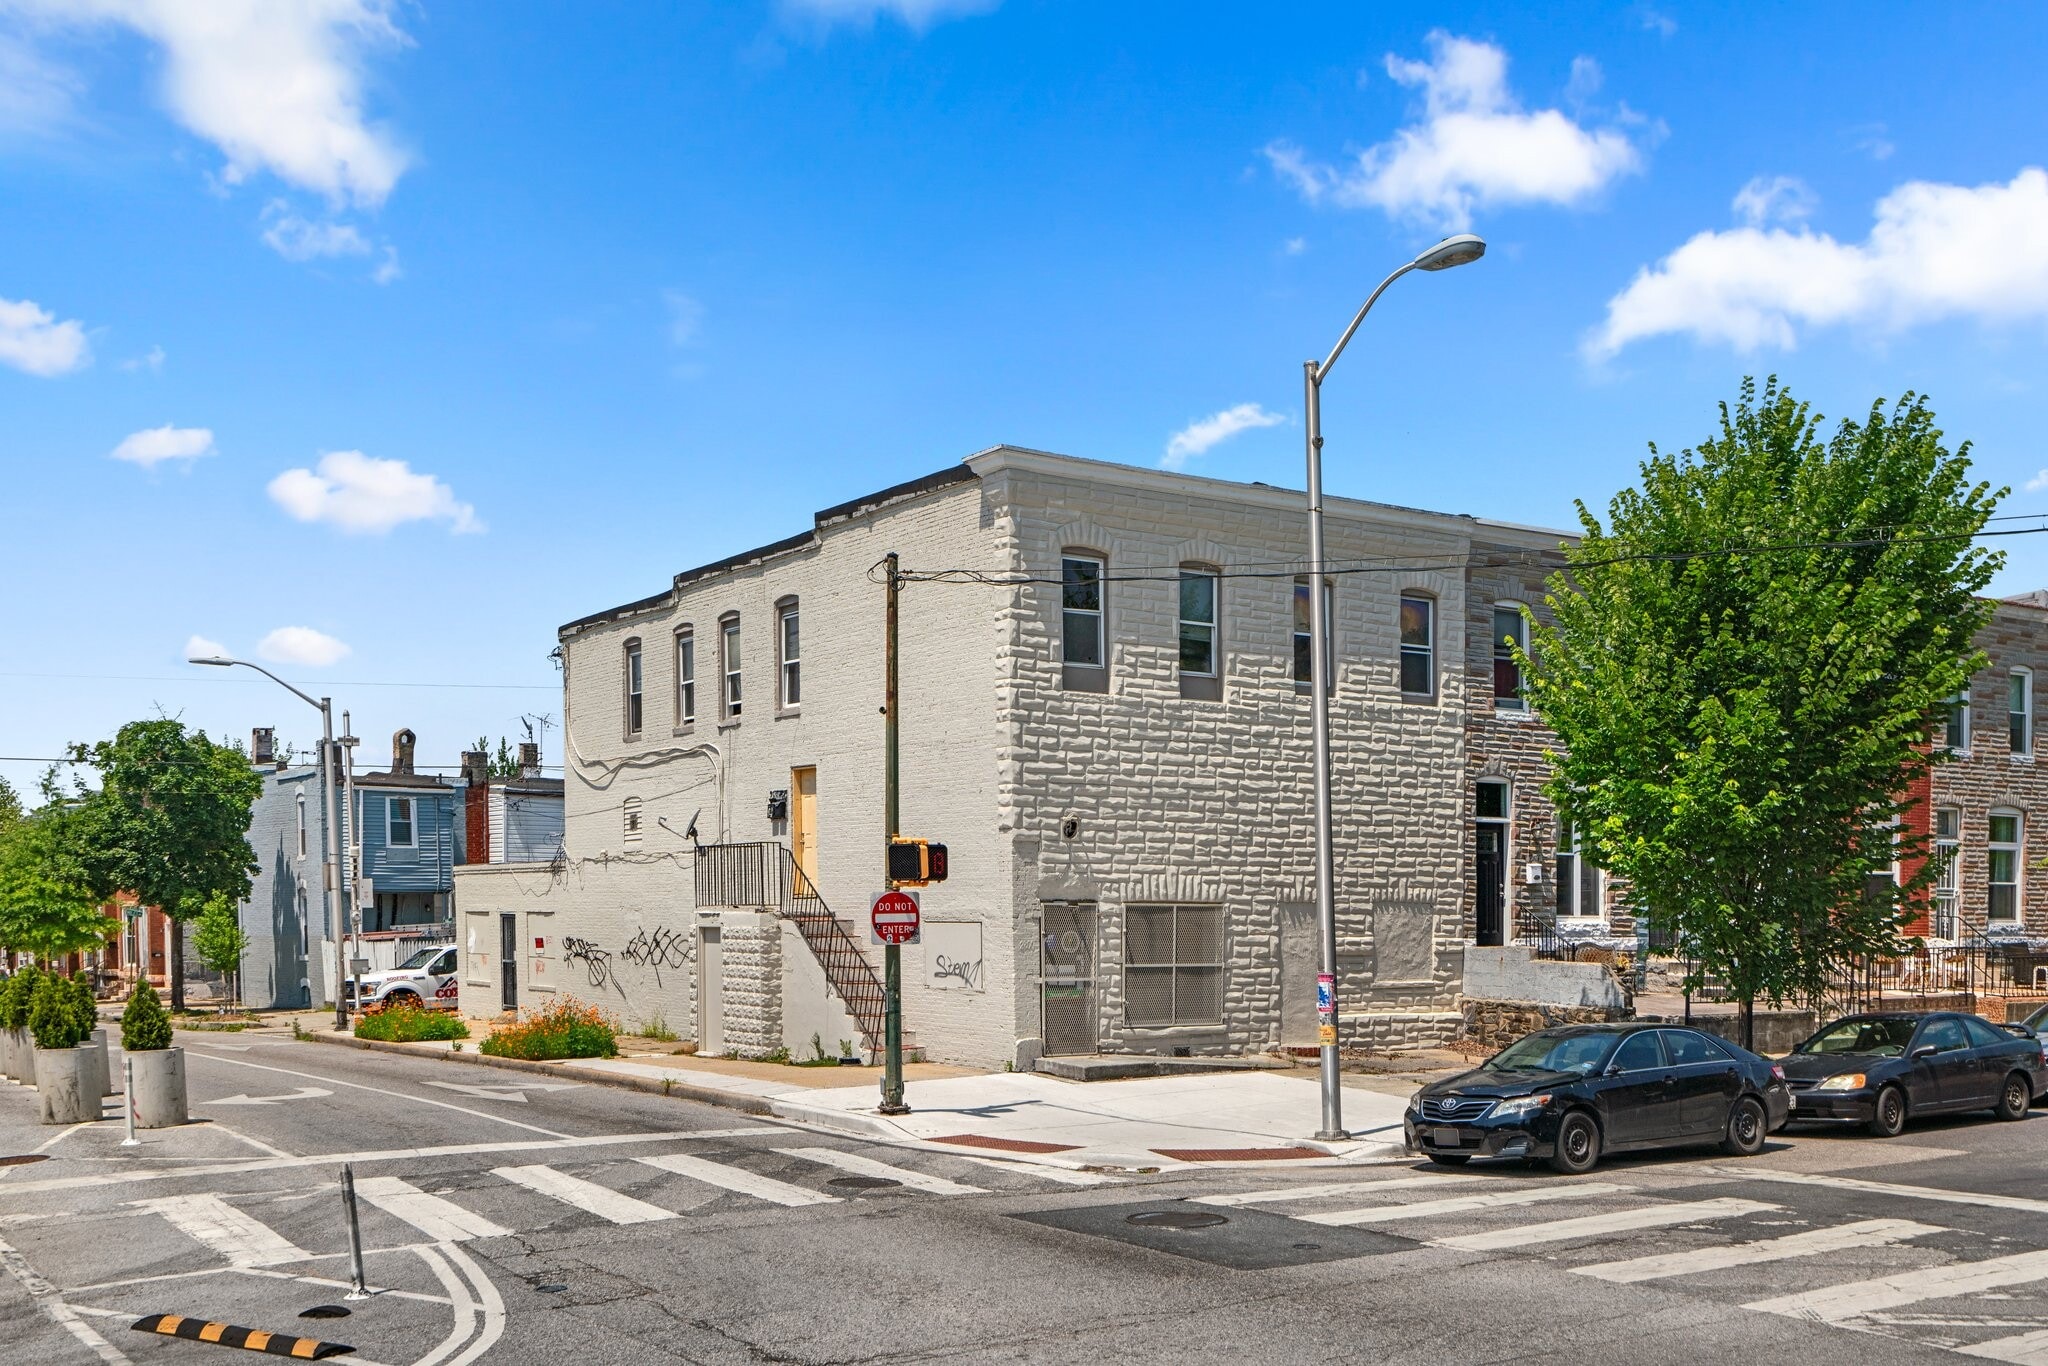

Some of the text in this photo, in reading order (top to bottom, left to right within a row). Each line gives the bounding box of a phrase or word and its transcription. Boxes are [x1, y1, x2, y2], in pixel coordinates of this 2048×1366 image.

[878, 902, 912, 911] DO NOT
[882, 925, 910, 934] ENTER
